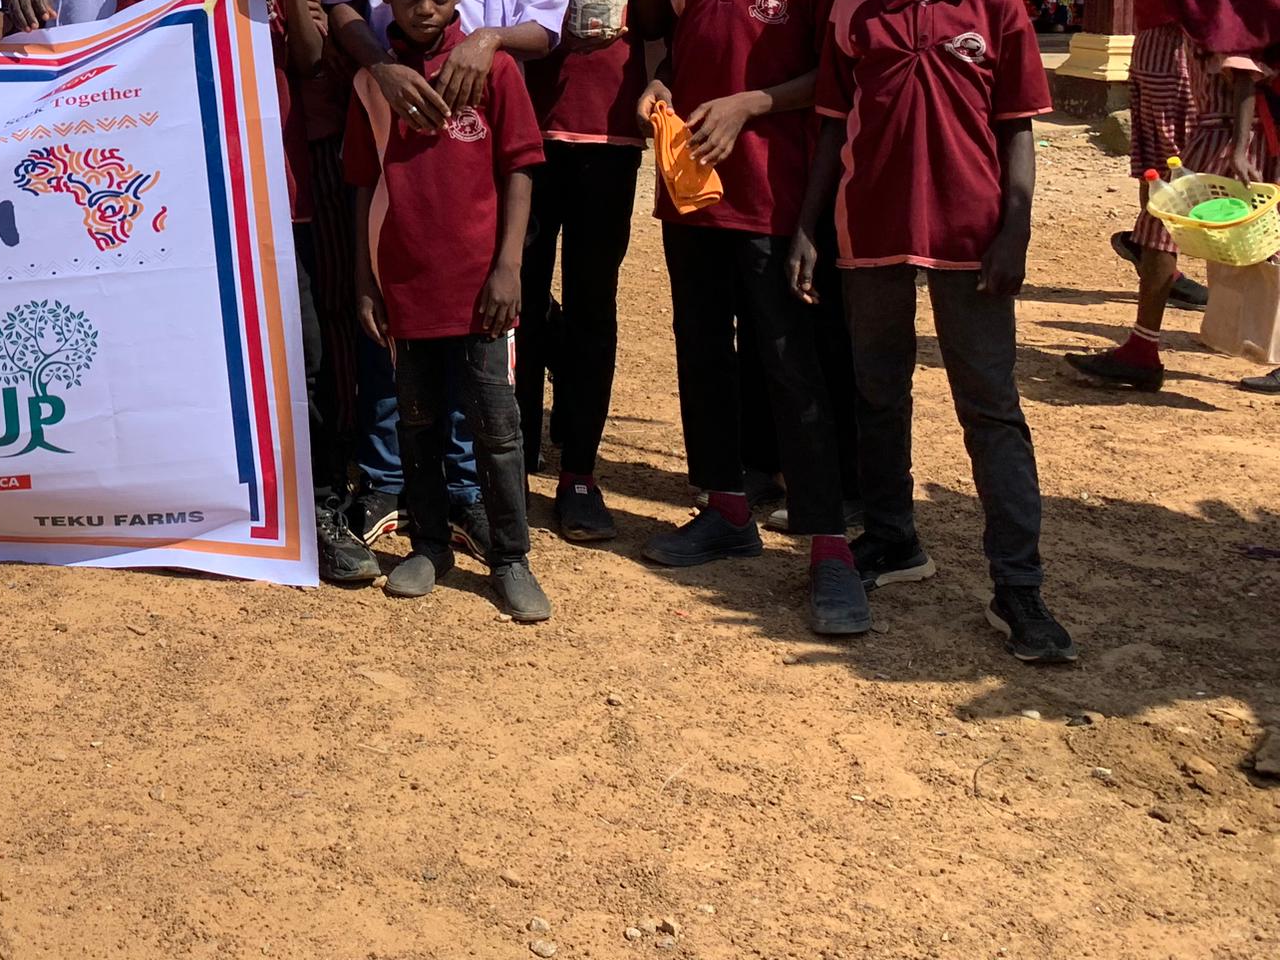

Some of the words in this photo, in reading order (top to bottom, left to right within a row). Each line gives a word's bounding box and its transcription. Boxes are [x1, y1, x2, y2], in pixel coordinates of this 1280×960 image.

[51, 87, 143, 109] Together
[33, 515, 104, 527] TEKU
[113, 510, 205, 527] FARMS
